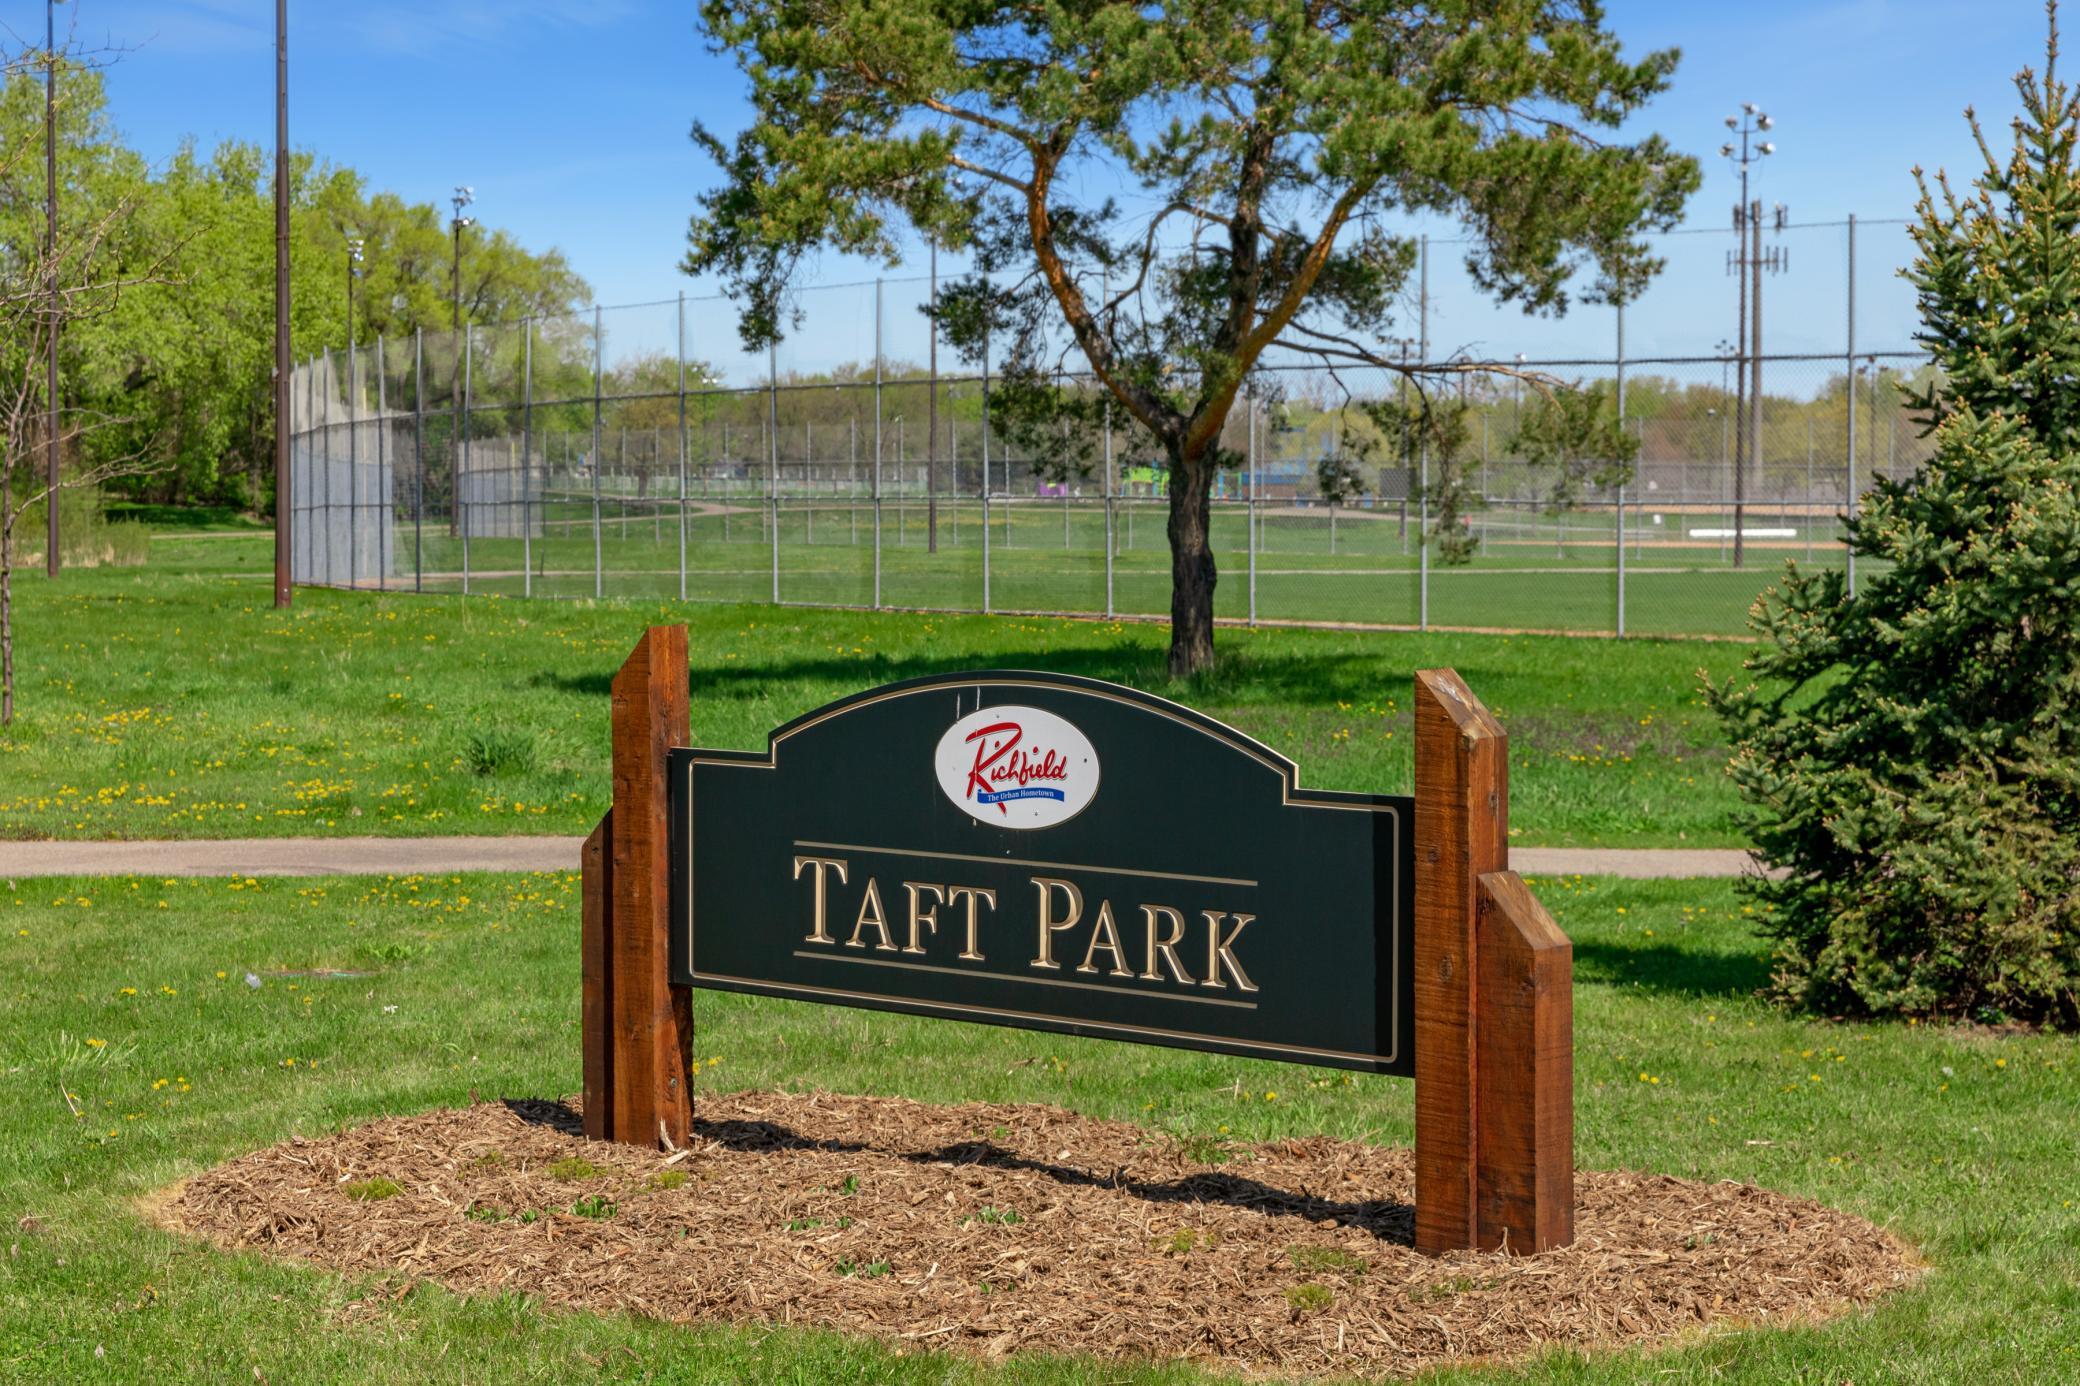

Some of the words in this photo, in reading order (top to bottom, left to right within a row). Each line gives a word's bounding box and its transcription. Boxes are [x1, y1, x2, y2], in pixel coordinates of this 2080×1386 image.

[965, 722, 1067, 816] Richfield
[988, 794, 999, 802] The
[1000, 791, 1019, 800] Urban
[1021, 789, 1054, 798] Hometown
[794, 856, 997, 961] TAFT
[1030, 877, 1259, 992] PARK
